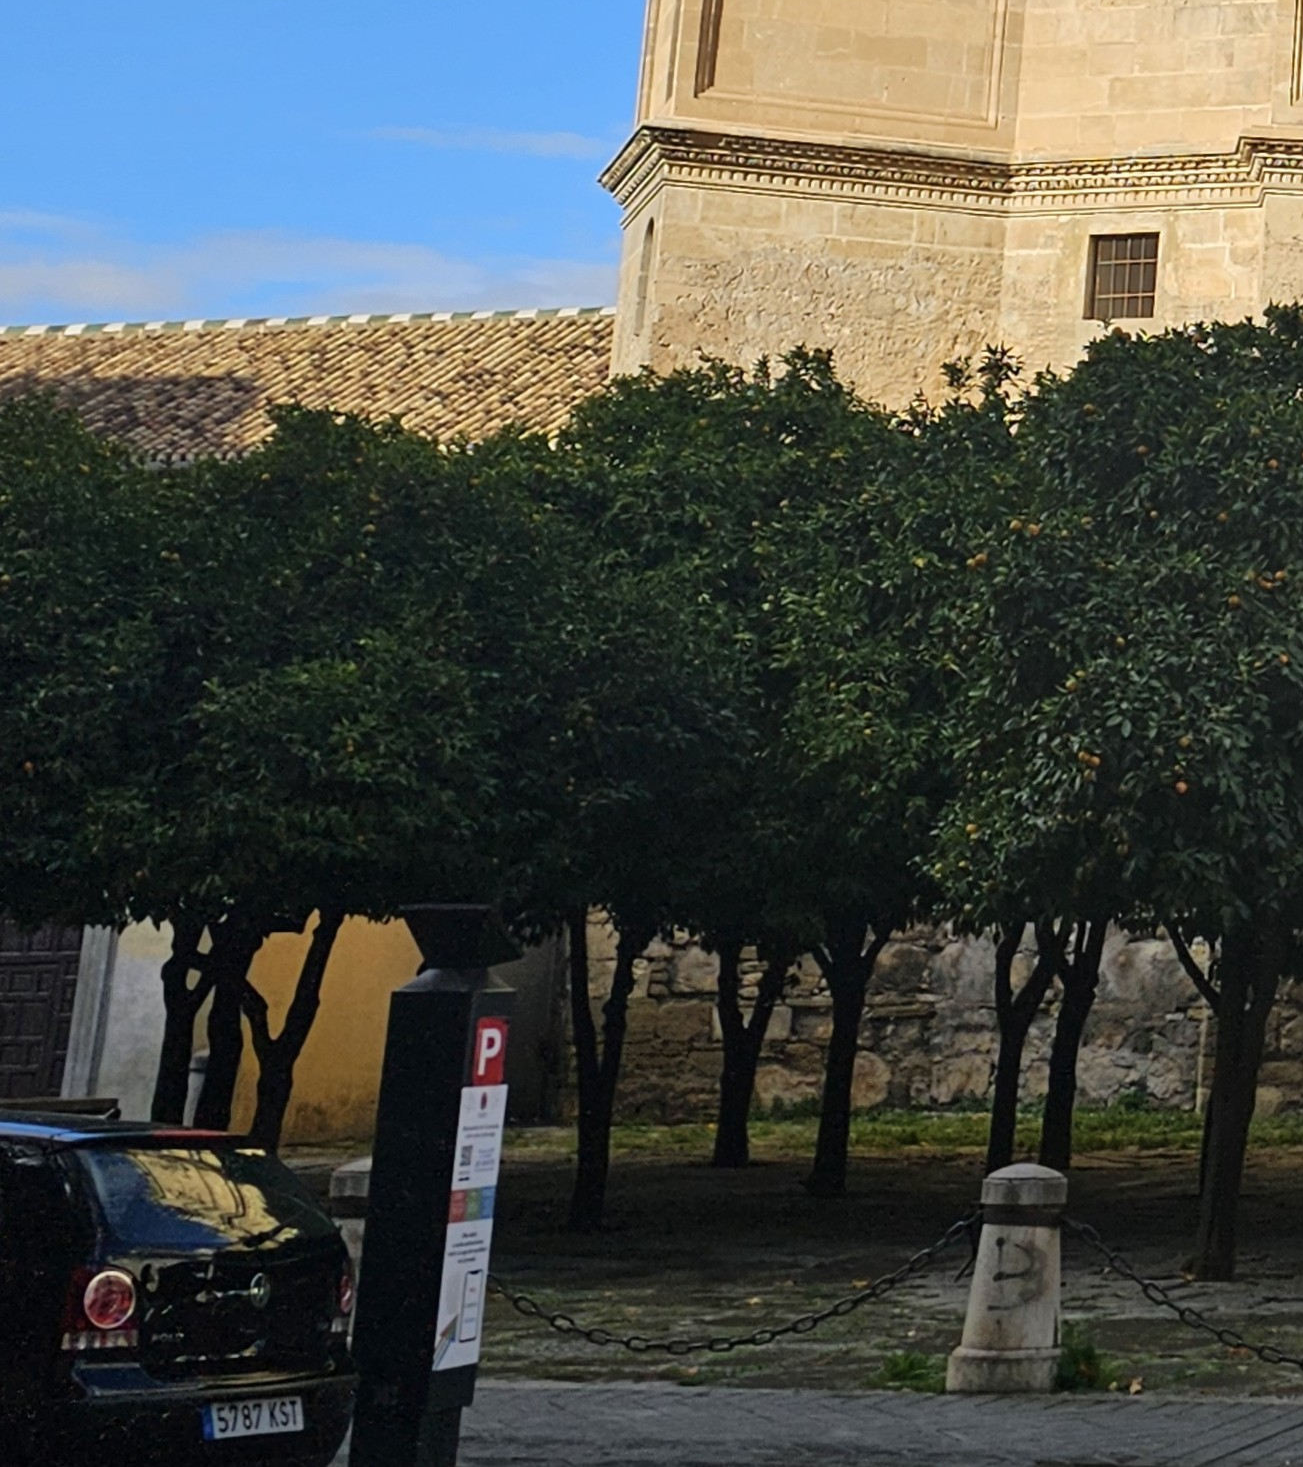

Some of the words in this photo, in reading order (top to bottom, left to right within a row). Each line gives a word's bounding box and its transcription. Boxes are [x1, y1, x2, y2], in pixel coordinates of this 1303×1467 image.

[477, 1027, 502, 1077] P
[215, 1402, 262, 1434] 5787
[268, 1399, 298, 1428] KST
